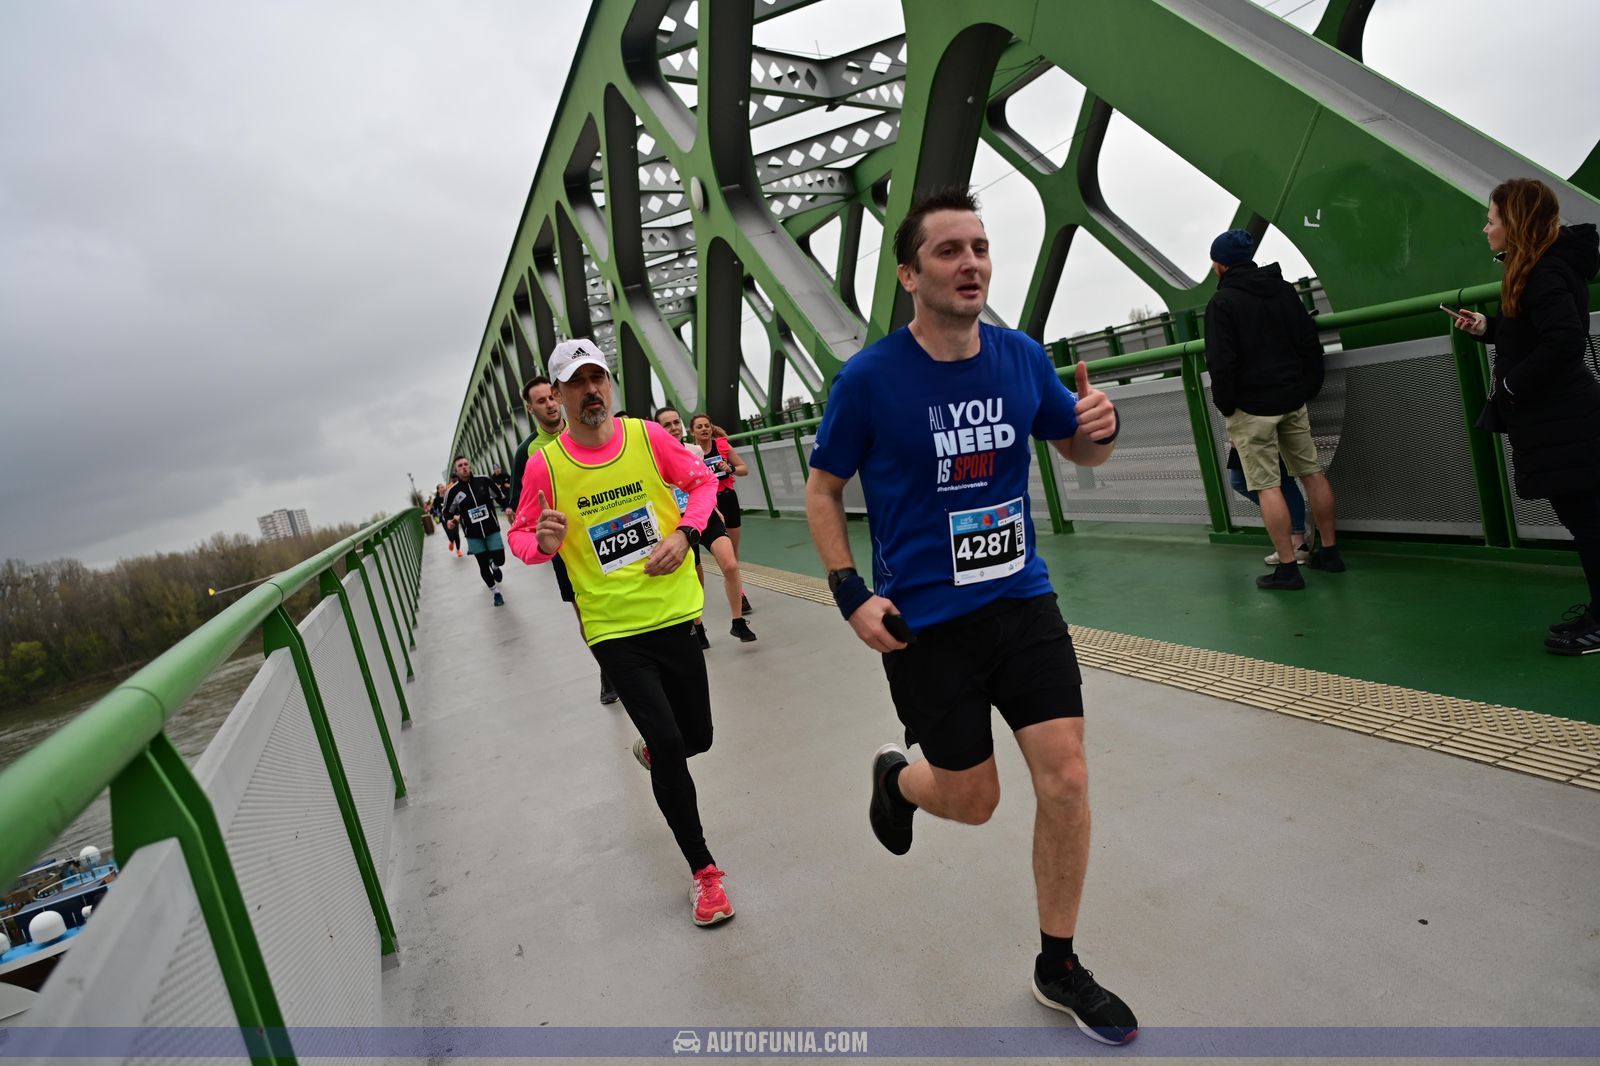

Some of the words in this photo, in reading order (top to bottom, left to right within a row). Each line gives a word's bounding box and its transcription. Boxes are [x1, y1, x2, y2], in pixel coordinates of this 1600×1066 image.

[928, 405, 947, 431] ALL
[948, 397, 1003, 428] YOU
[933, 423, 1016, 458] NEED
[937, 458, 952, 484] IS
[953, 451, 997, 481] SPORT
[580, 493, 648, 517] www.autofunia.com
[590, 481, 643, 507] AUTOFUNIA
[598, 528, 640, 557] 4798
[956, 528, 1011, 561] 4287
